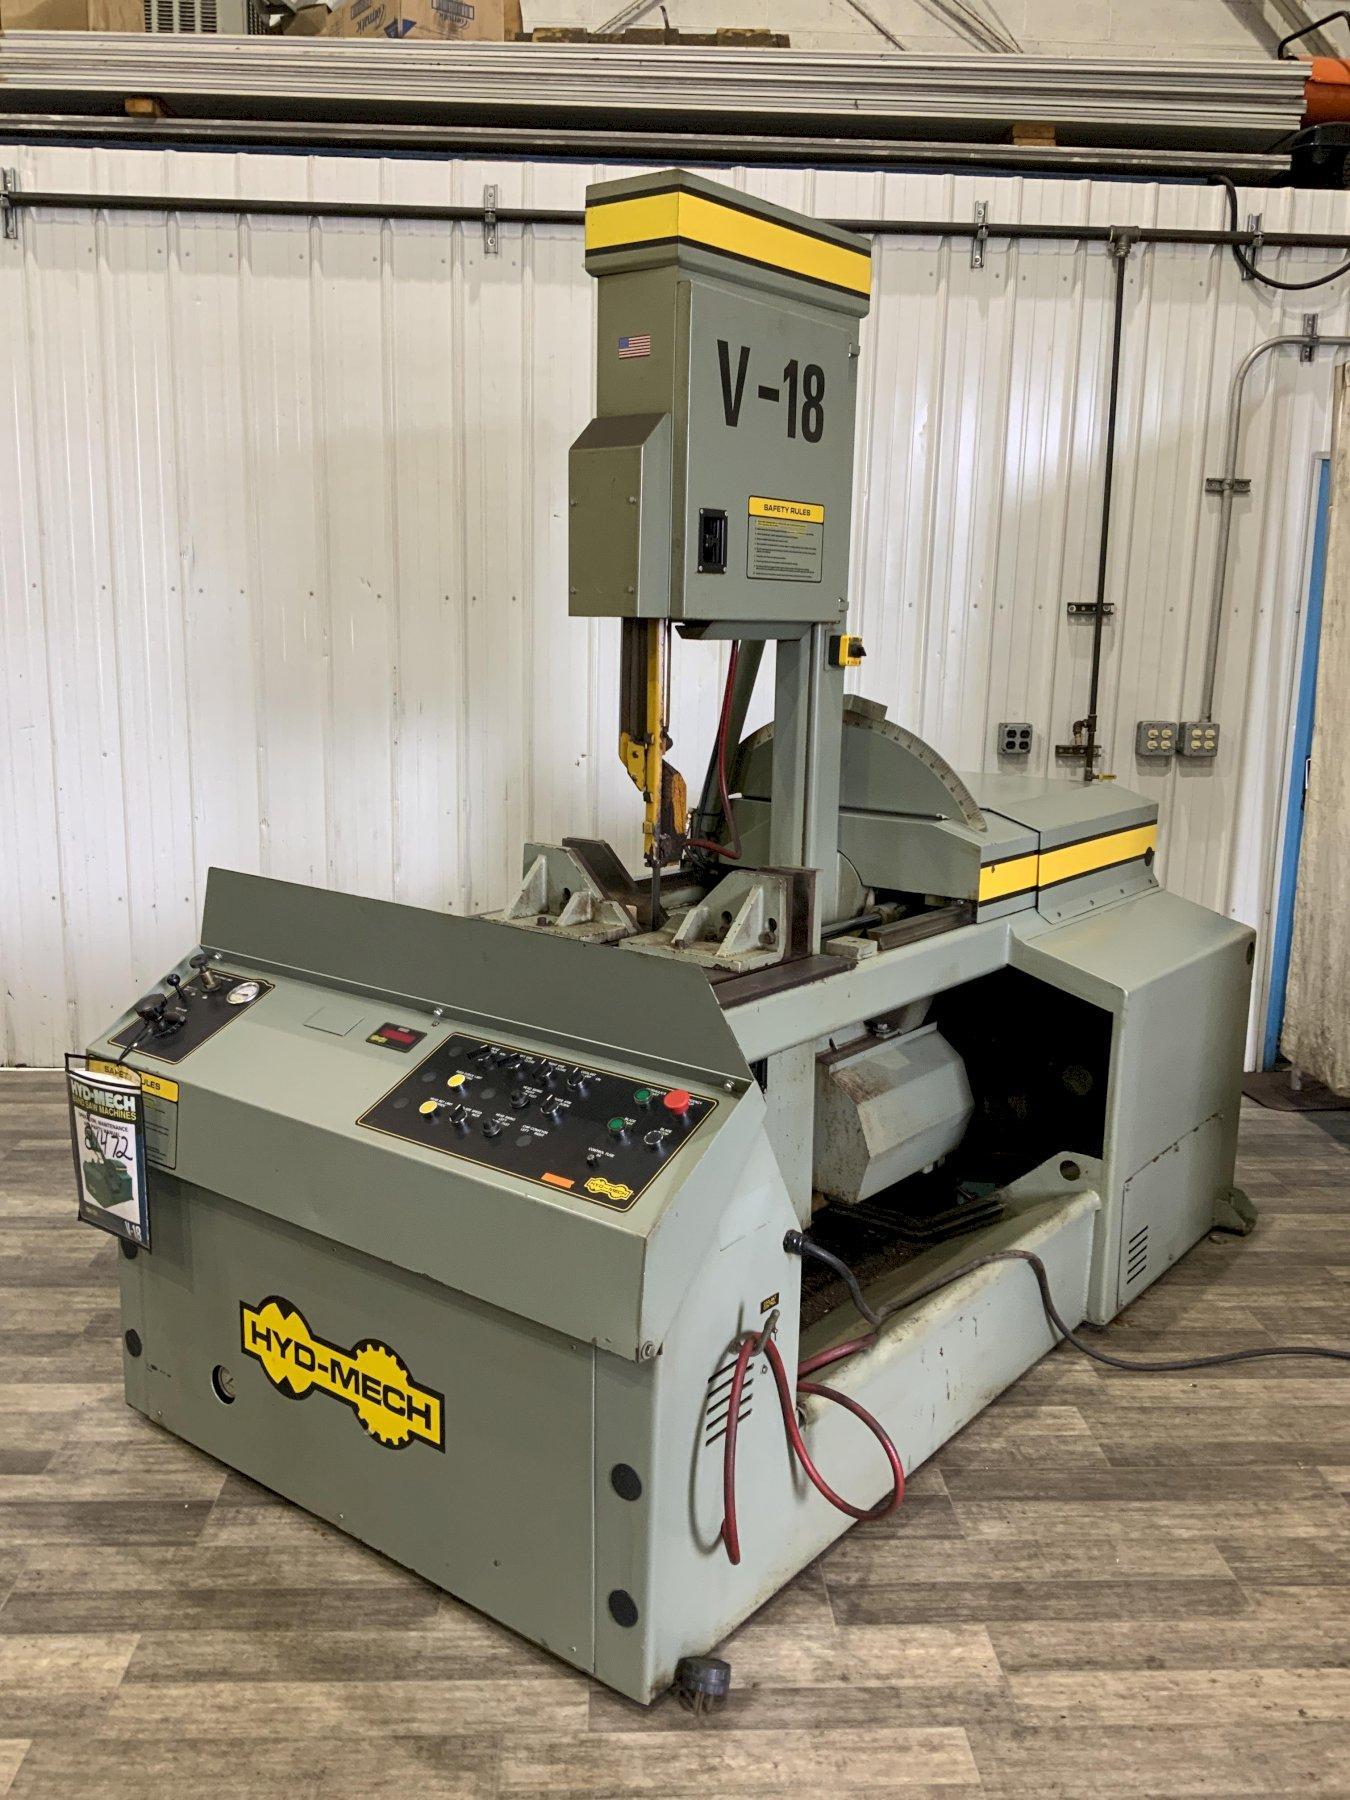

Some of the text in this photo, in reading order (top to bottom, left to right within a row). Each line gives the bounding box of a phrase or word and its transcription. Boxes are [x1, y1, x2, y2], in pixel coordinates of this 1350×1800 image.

[717, 339, 825, 443] V-18
[763, 503, 811, 517] SAFETY RULES
[104, 1065, 132, 1079] SAFET
[71, 1080, 136, 1112] HYD-MECH
[98, 1105, 137, 1121] MACHINES
[251, 1320, 432, 1431] HYD-MECH
